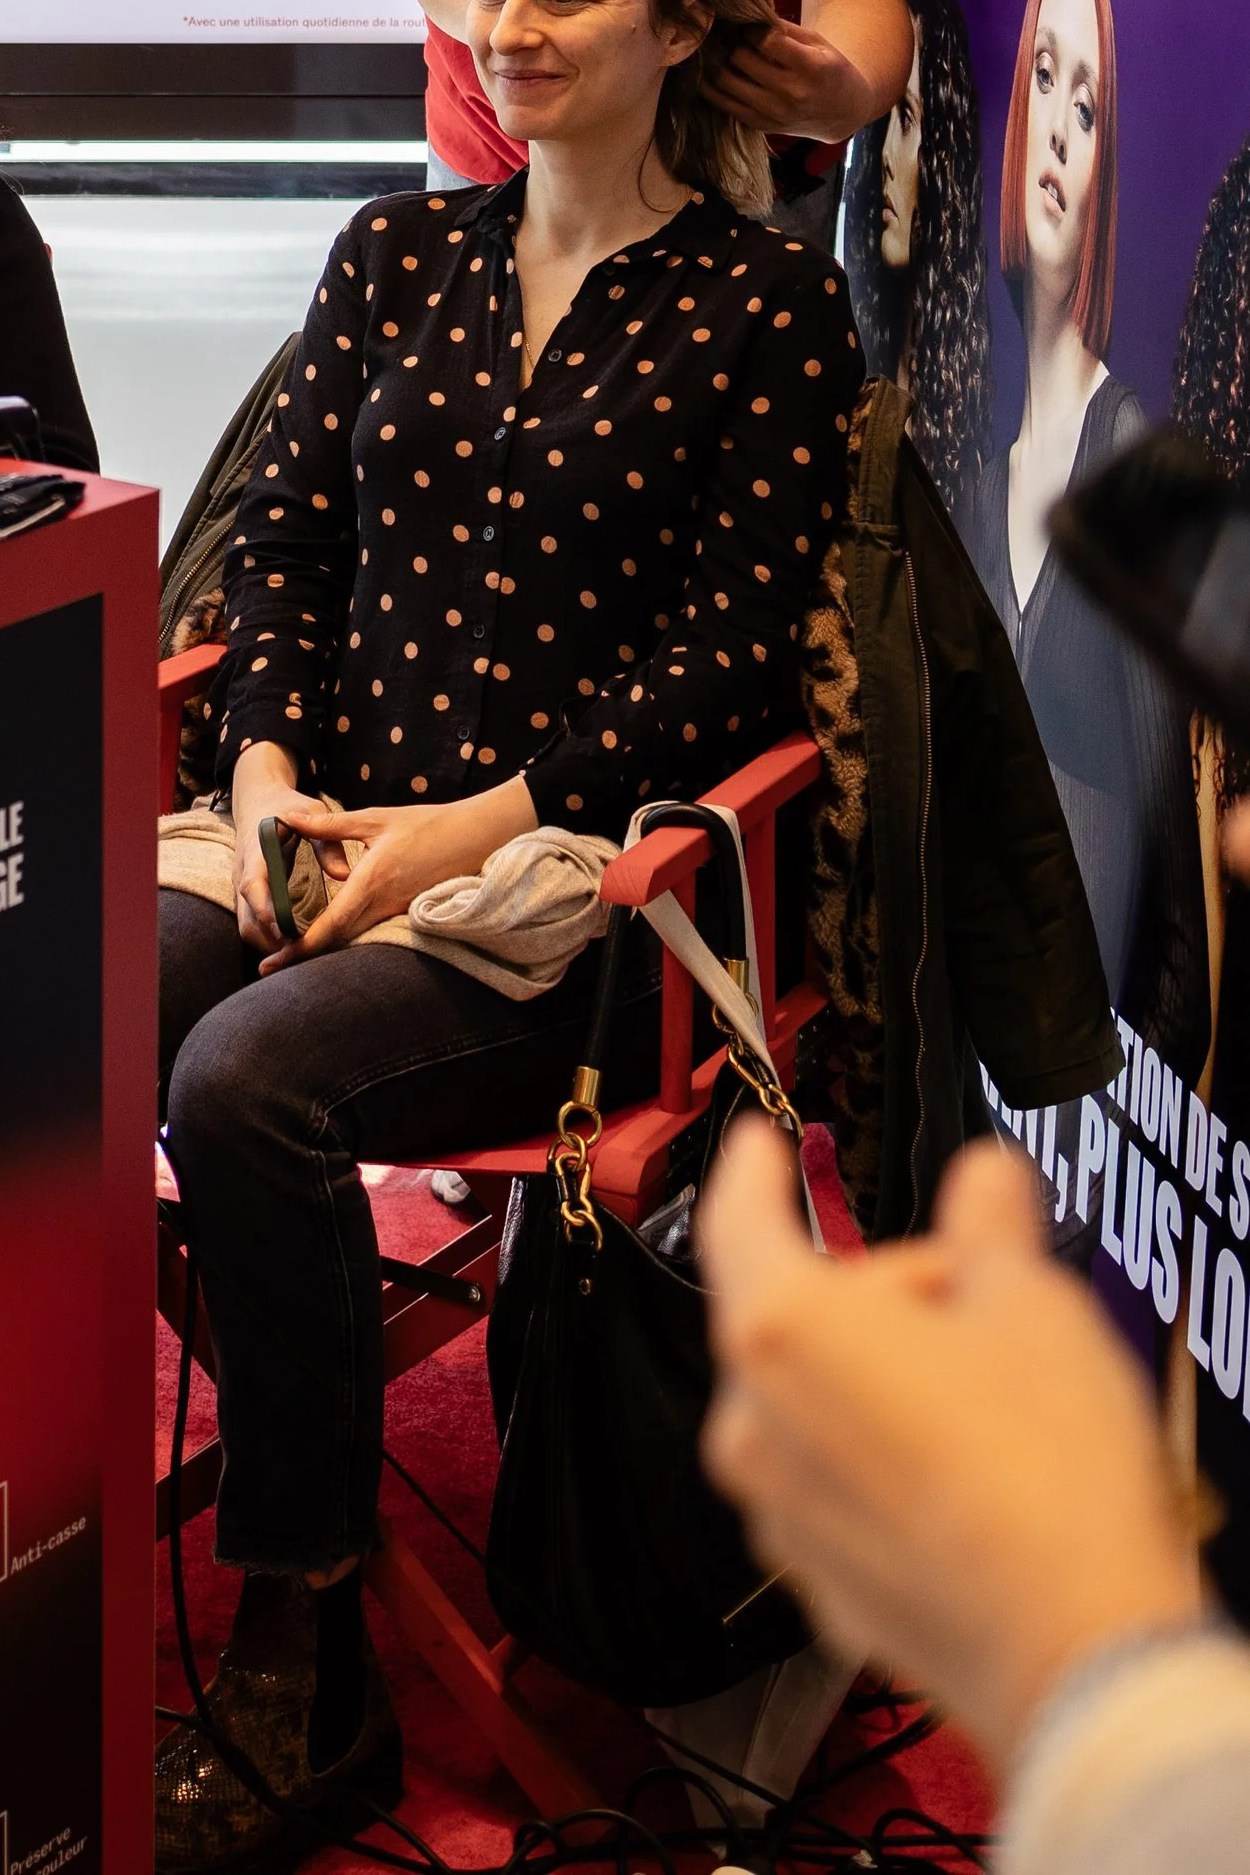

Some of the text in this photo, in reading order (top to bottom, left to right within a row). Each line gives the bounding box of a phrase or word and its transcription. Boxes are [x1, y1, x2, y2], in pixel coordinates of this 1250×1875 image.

[219, 18, 240, 27] une
[244, 17, 299, 27] utilisation
[302, 17, 373, 29] quotidienne
[375, 17, 387, 27] de
[390, 17, 399, 27] la
[403, 18, 426, 27] rout
[1185, 1090, 1227, 1217] DE
[1076, 1092, 1182, 1324] PLUS
[10, 1516, 87, 1575] Anti-casse
[10, 1827, 71, 1875] Préserve
